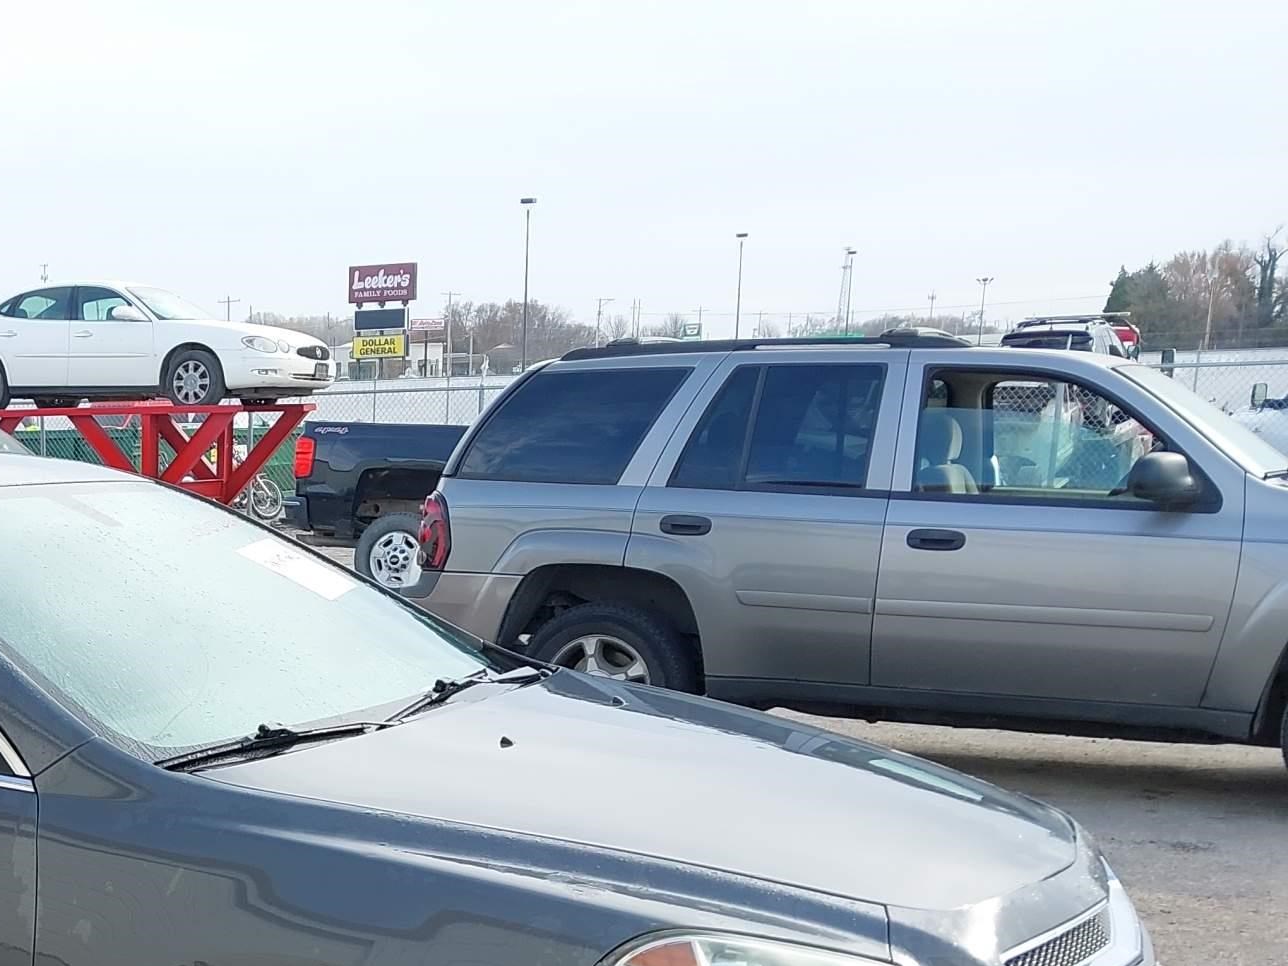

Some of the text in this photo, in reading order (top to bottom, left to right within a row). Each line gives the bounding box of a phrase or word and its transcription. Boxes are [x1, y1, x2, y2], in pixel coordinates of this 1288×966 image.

[352, 269, 411, 289] Leeker's
[354, 290, 381, 298] FAMILY
[362, 338, 396, 347] DOLLAR
[359, 346, 398, 356] GENERAL
